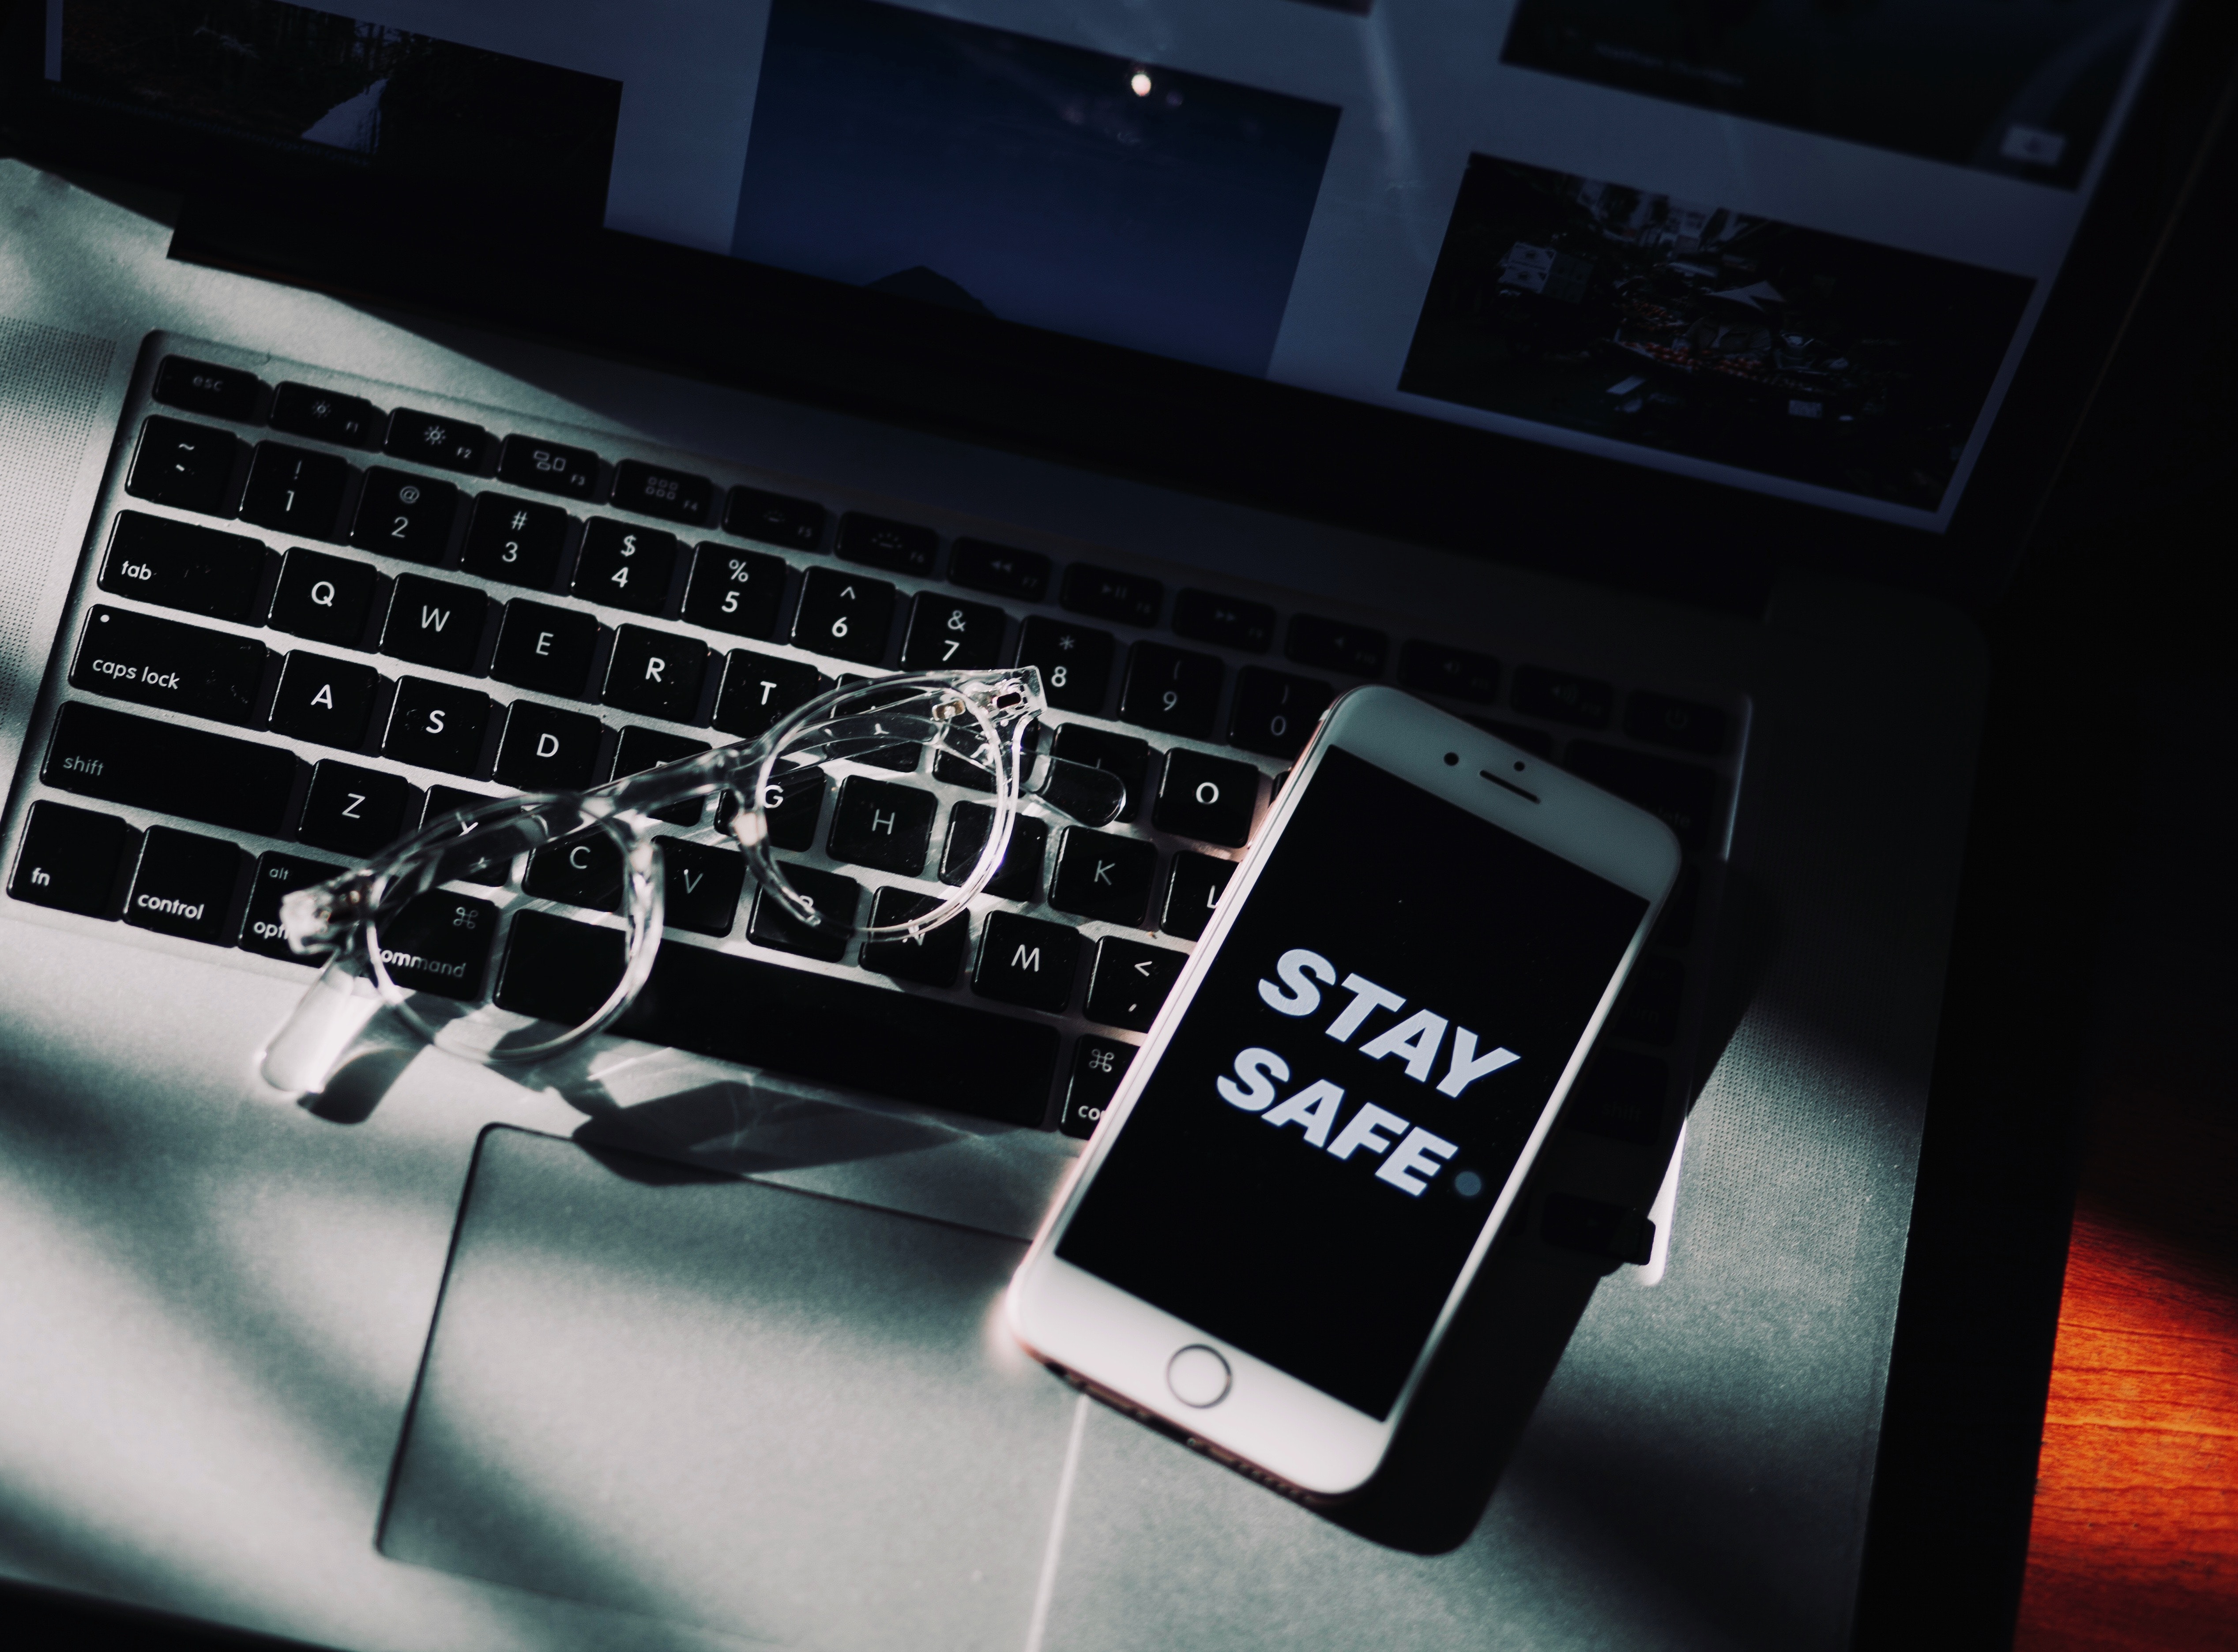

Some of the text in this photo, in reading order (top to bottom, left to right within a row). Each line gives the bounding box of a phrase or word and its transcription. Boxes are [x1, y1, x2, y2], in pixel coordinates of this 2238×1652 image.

[192, 374, 224, 392] esc
[345, 421, 359, 434] F1
[456, 446, 472, 460] F2
[570, 473, 586, 486] F3
[285, 489, 295, 512] 1
[399, 485, 421, 505] @
[683, 499, 699, 512] F4
[391, 516, 410, 538] 2
[511, 511, 529, 532] #
[797, 525, 812, 539] F5
[502, 541, 518, 563] 3
[620, 534, 637, 558] $
[910, 551, 925, 564] F6
[120, 560, 152, 581] tab
[611, 566, 629, 589] 4
[728, 559, 750, 582] %
[310, 581, 335, 607] Q
[721, 591, 741, 613] 5
[421, 604, 451, 633] W
[831, 616, 848, 638] 6
[946, 610, 967, 633] &
[534, 631, 555, 657] E
[942, 640, 959, 662] 7
[92, 658, 181, 691] caps lock
[645, 657, 665, 683] R
[1050, 665, 1068, 688] 8
[310, 683, 334, 710] A
[760, 680, 777, 706] T
[1162, 691, 1178, 712] 9
[425, 709, 446, 734] S
[1270, 715, 1288, 737] 0
[535, 733, 560, 758] D
[63, 755, 105, 777] shift
[762, 785, 785, 809] G
[1195, 781, 1219, 806] O
[341, 792, 366, 819] Z
[871, 808, 896, 836] H
[569, 845, 592, 871] C
[30, 867, 51, 887] fn
[268, 866, 290, 881] alt
[683, 868, 704, 894] V
[1093, 859, 1116, 886] K
[137, 893, 205, 921] control
[1206, 884, 1220, 909] L
[380, 949, 467, 979] ommand
[1010, 943, 1041, 973] M
[1257, 948, 1522, 1100] STAY
